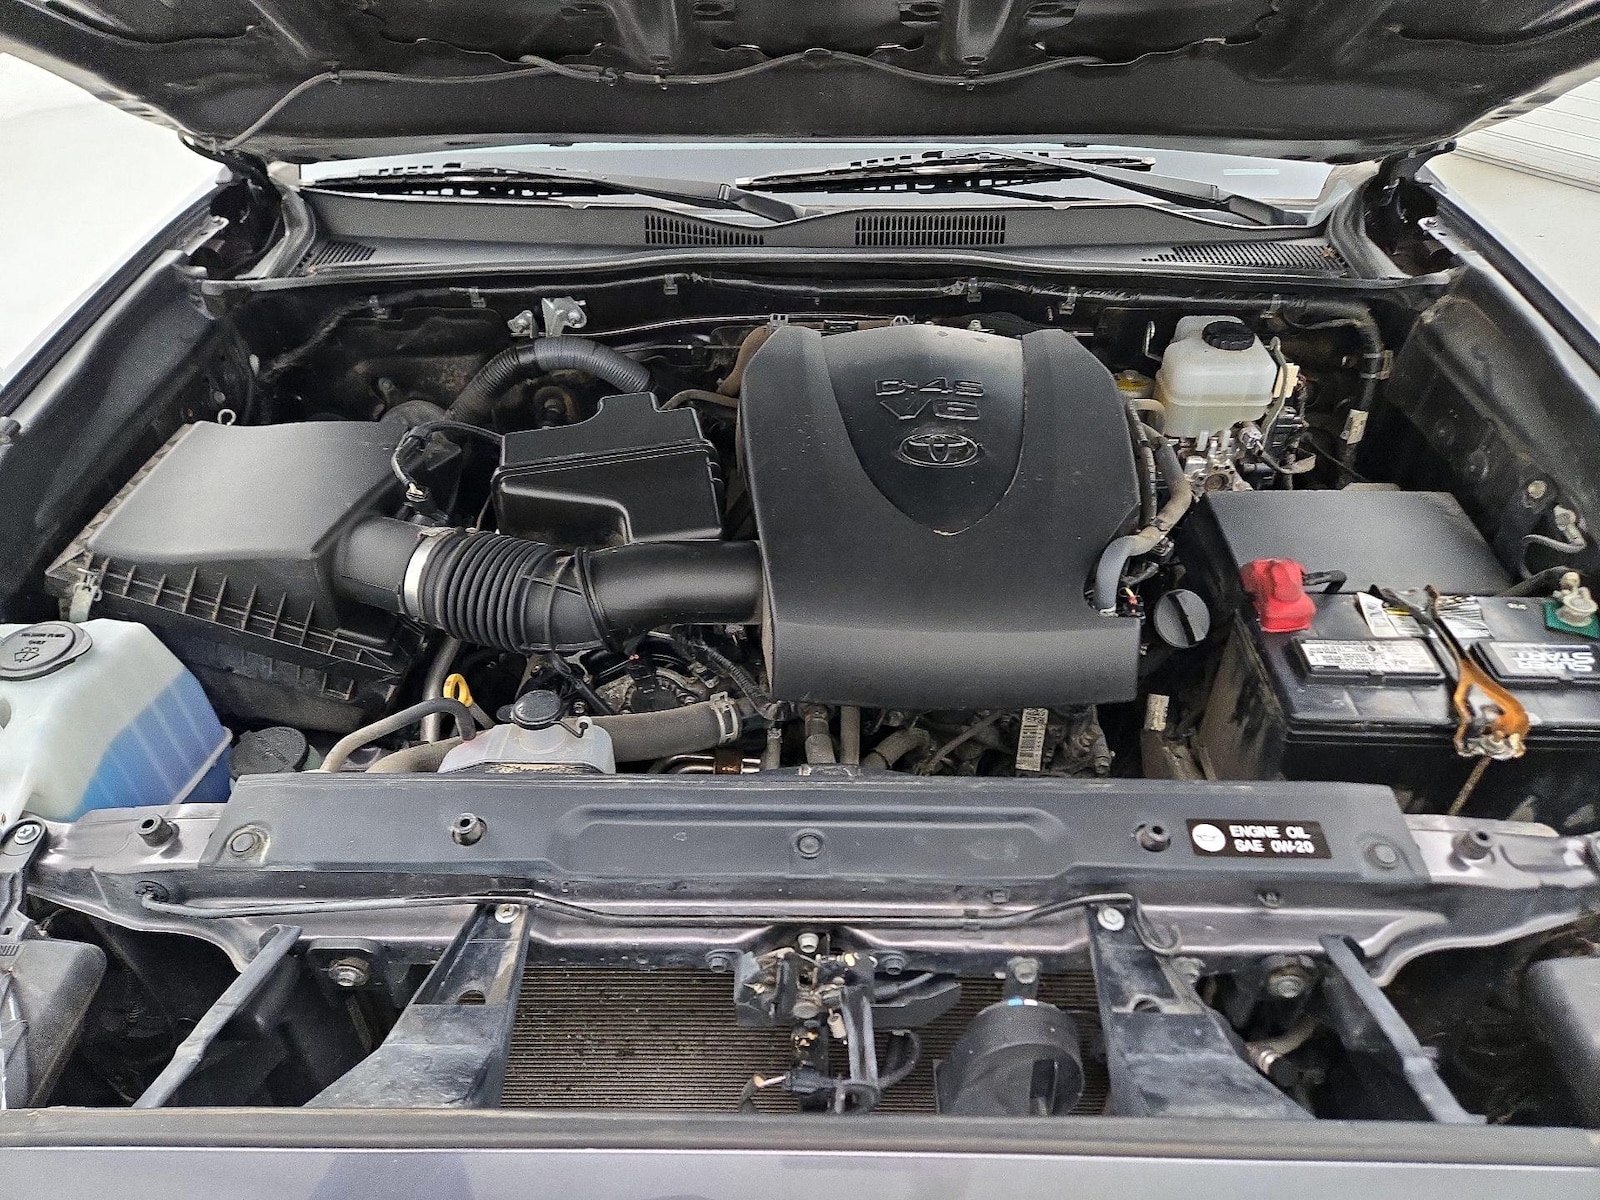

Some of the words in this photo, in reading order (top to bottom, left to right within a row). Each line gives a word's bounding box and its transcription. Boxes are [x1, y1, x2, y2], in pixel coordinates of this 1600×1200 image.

[879, 398, 981, 421] V6
[1511, 651, 1596, 664] START
[1516, 660, 1593, 672] SUPER
[1229, 824, 1281, 839] ENGINE
[1285, 826, 1312, 840] OIL
[1234, 839, 1265, 852] SAE
[1270, 840, 1315, 854] 0W-20
